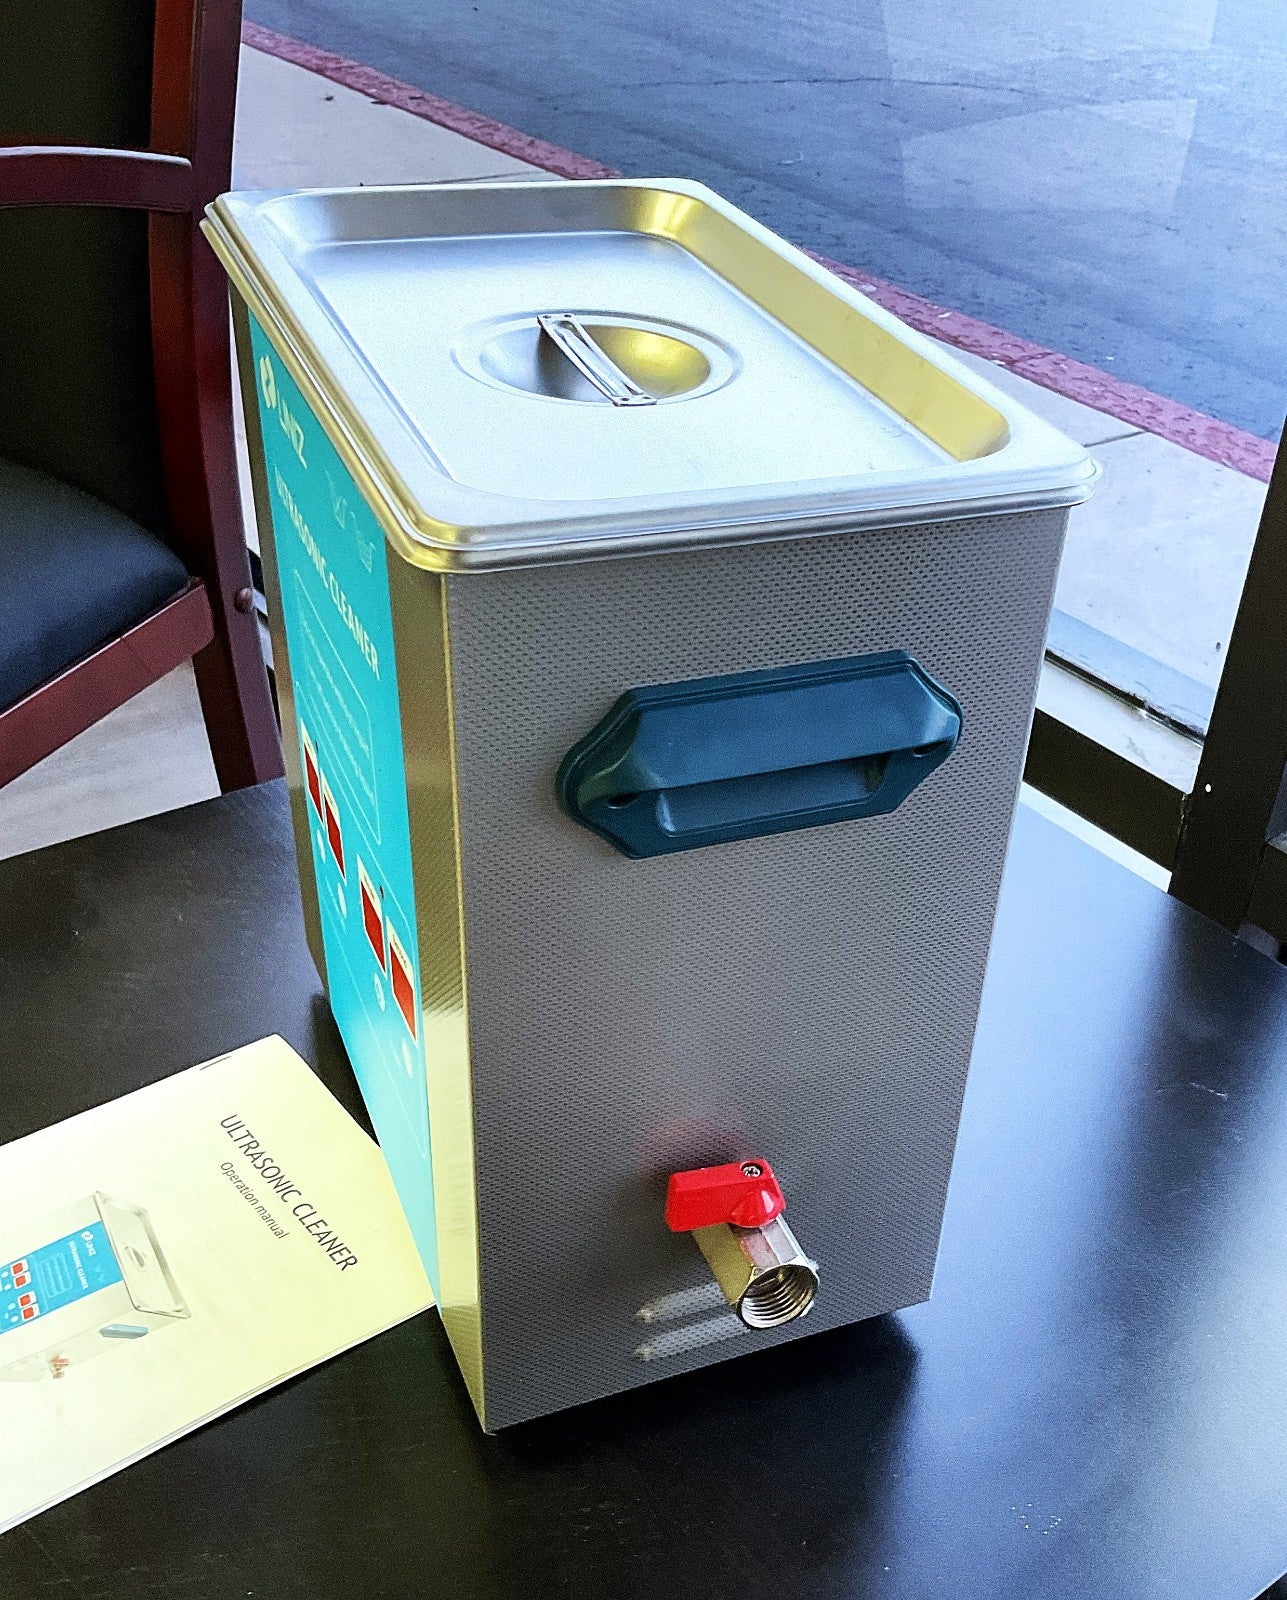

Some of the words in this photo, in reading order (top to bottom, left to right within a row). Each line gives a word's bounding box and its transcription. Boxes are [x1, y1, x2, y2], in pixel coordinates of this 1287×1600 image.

[328, 571, 380, 681] CLEANER
[220, 1113, 302, 1203] ULTRASONIC
[292, 1203, 359, 1272] CLEANER
[220, 1161, 259, 1206] Operation
[254, 1205, 290, 1239] manual
